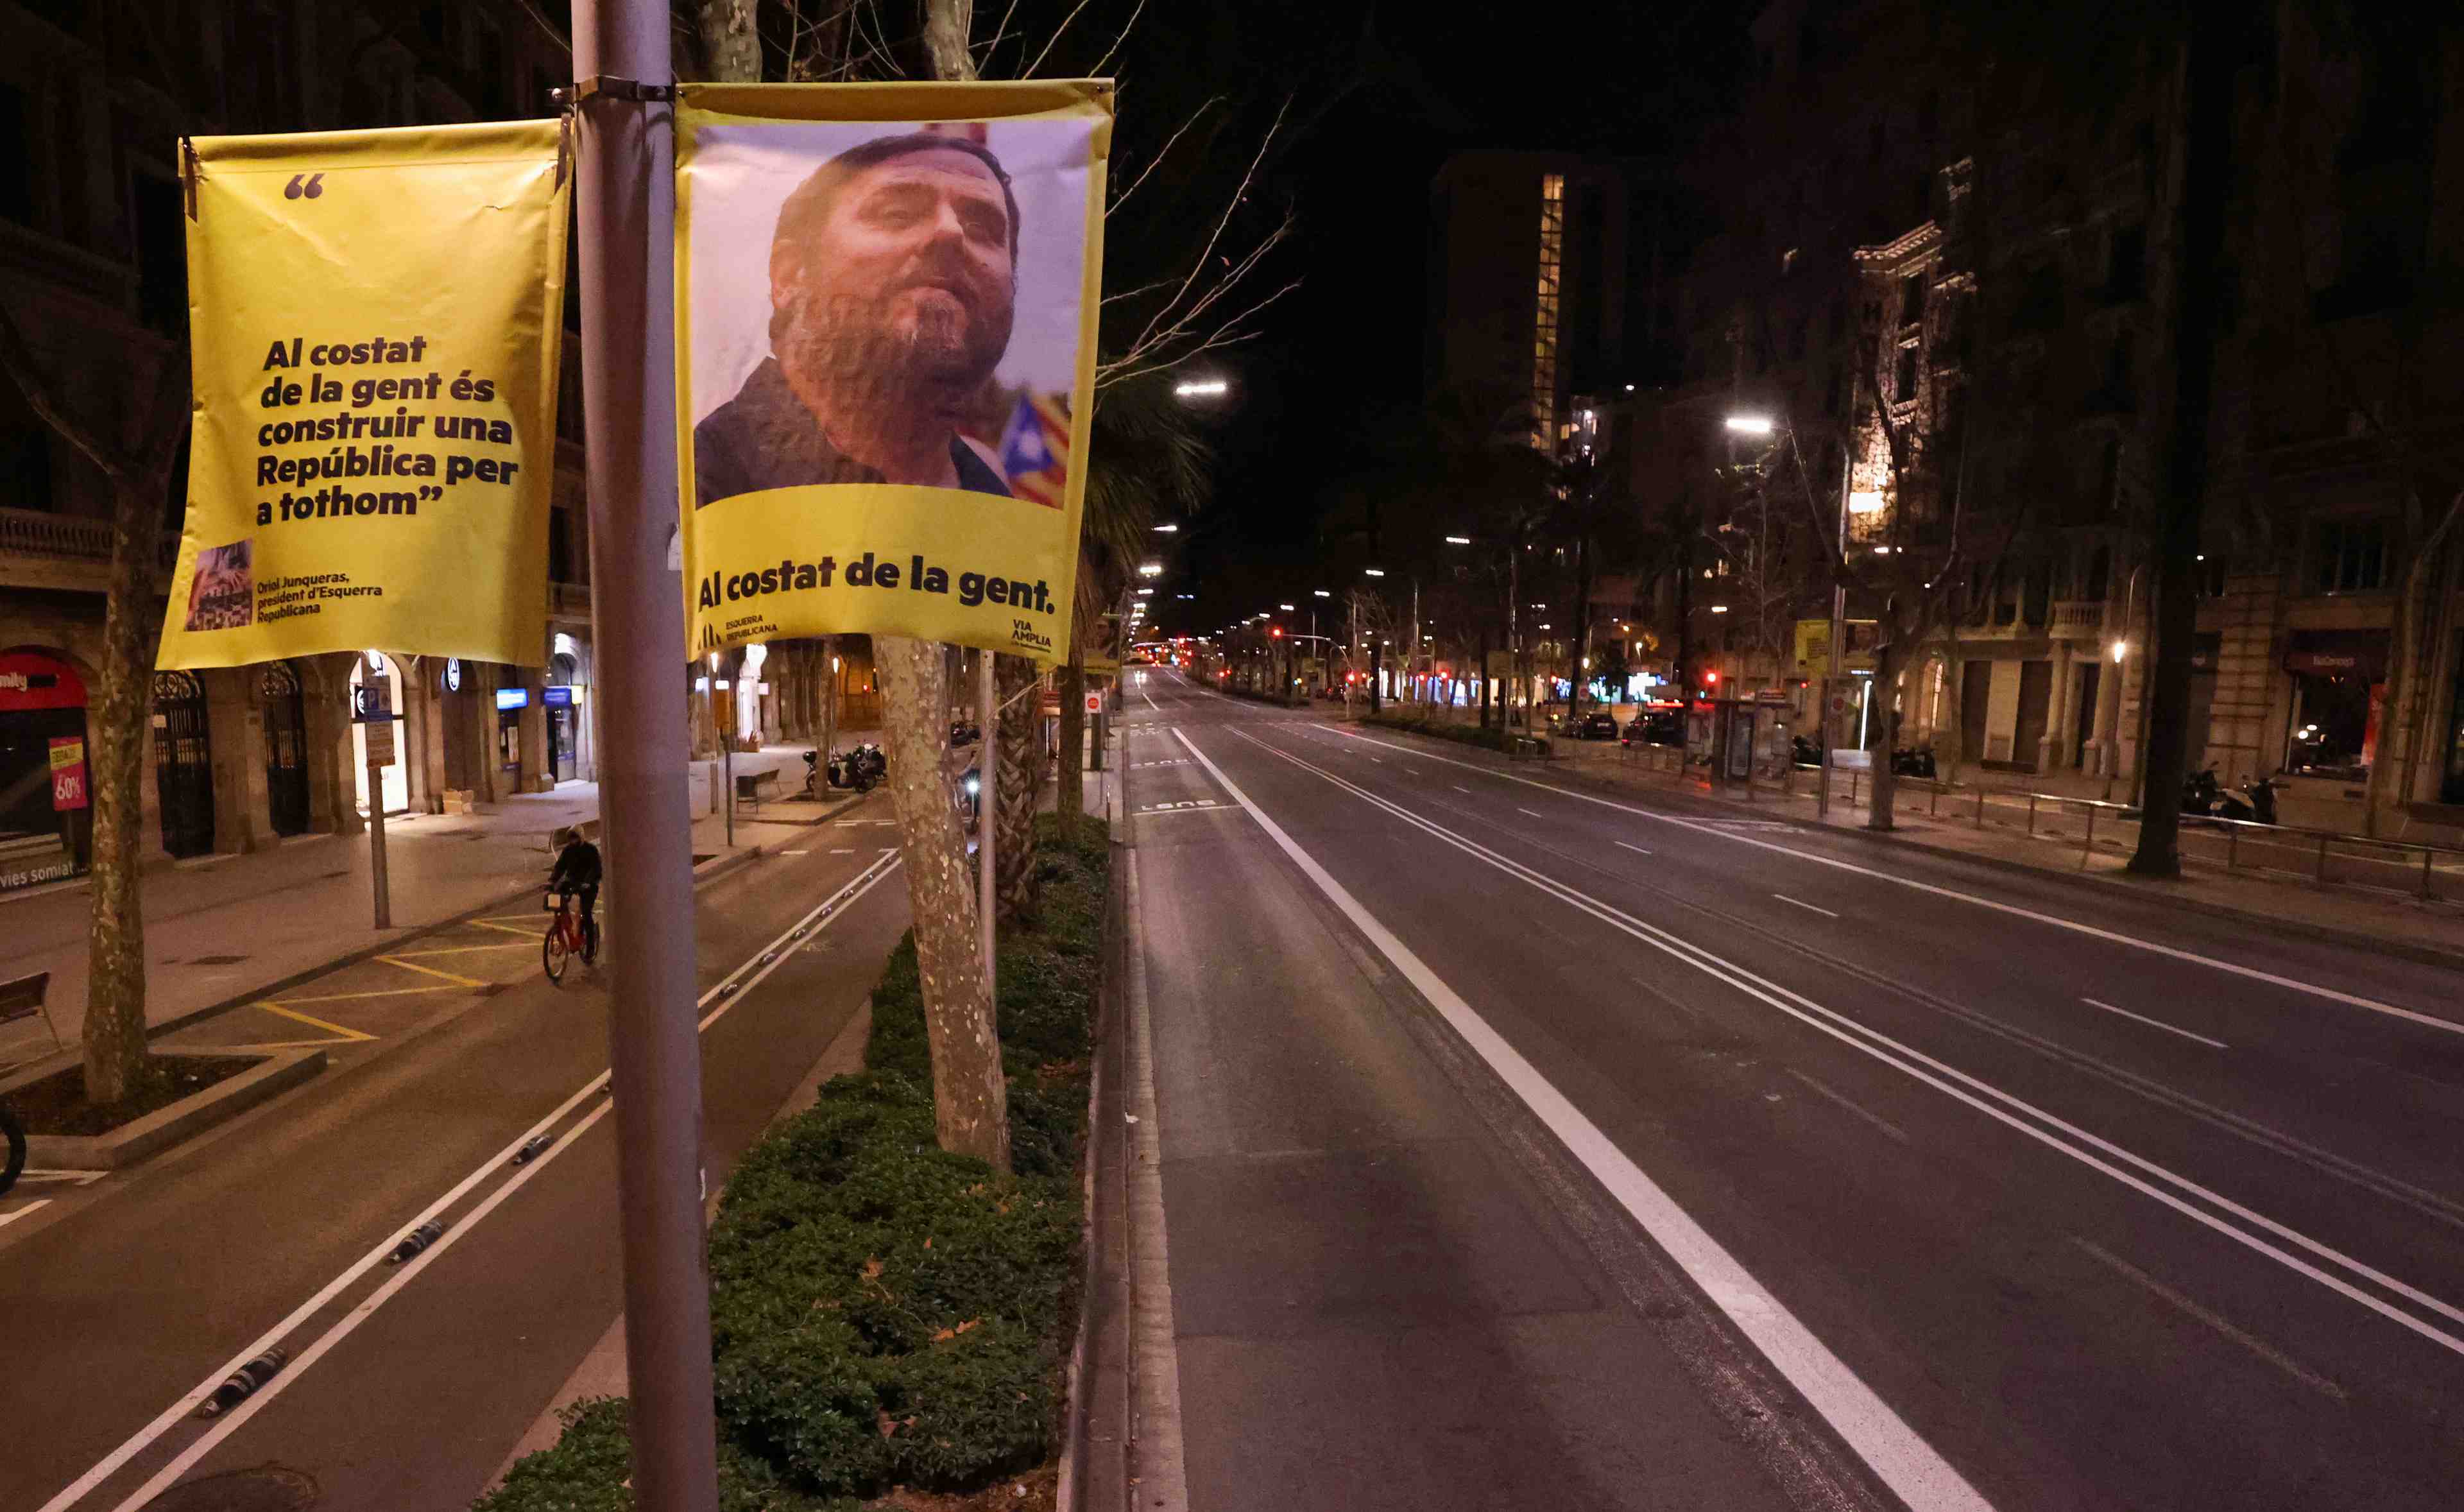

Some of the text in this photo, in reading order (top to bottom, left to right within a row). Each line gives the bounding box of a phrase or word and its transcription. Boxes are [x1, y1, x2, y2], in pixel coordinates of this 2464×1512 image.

[263, 336, 427, 370] Al costat
[261, 370, 495, 408] de la gent és
[258, 407, 512, 447] construir una
[257, 445, 518, 486] República per
[257, 501, 271, 526] a
[257, 572, 350, 594] Oriol Junqueras,
[699, 552, 1055, 614] Al costat de la gent.
[257, 586, 383, 610] president d'Esquerra
[257, 603, 321, 624] Republicana
[726, 615, 764, 630] ESQUERRA
[1013, 619, 1032, 632] VIA
[1012, 630, 1051, 647] AMPLIA
